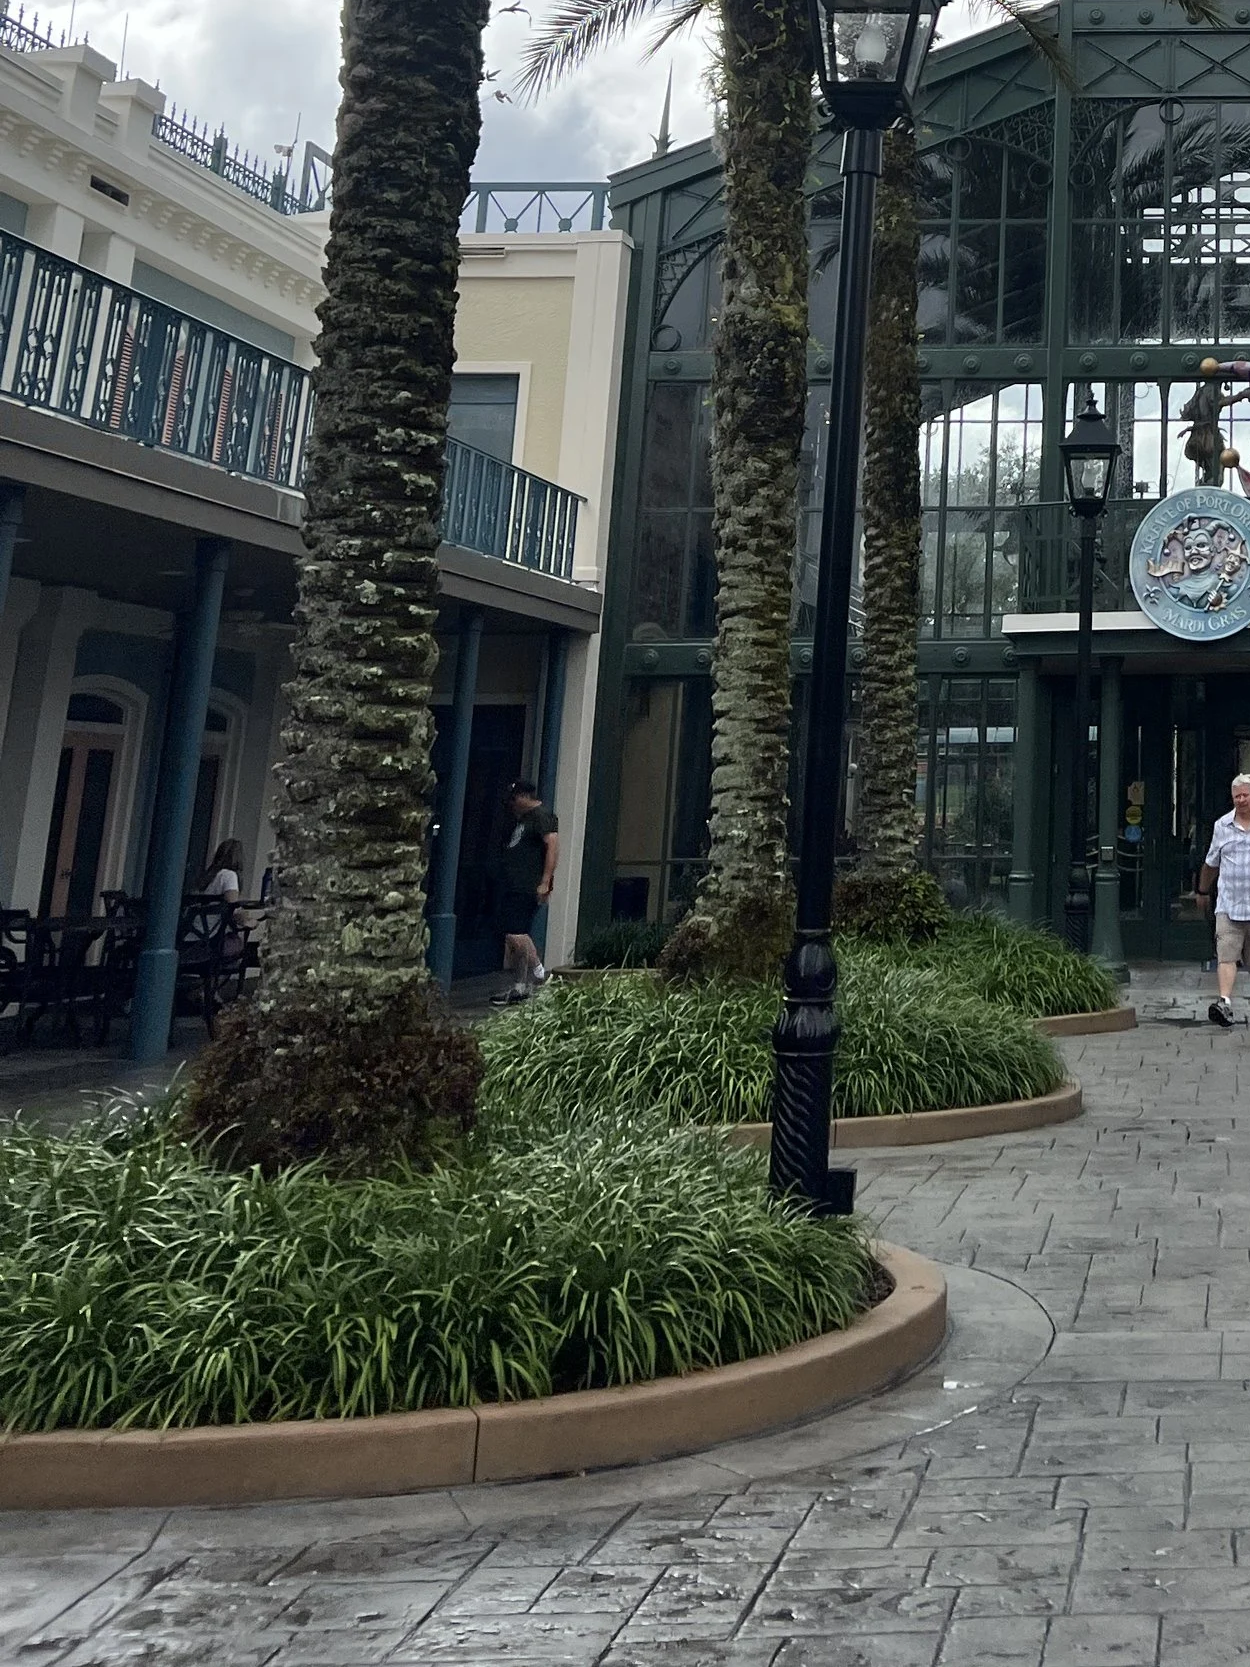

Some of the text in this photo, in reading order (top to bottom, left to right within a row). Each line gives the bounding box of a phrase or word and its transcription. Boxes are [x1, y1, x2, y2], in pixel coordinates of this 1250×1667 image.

[1140, 509, 1178, 554] KREWE
[1176, 497, 1191, 512] OF
[1196, 495, 1231, 514] PORT
[1161, 606, 1247, 632] MARDI GRAS
